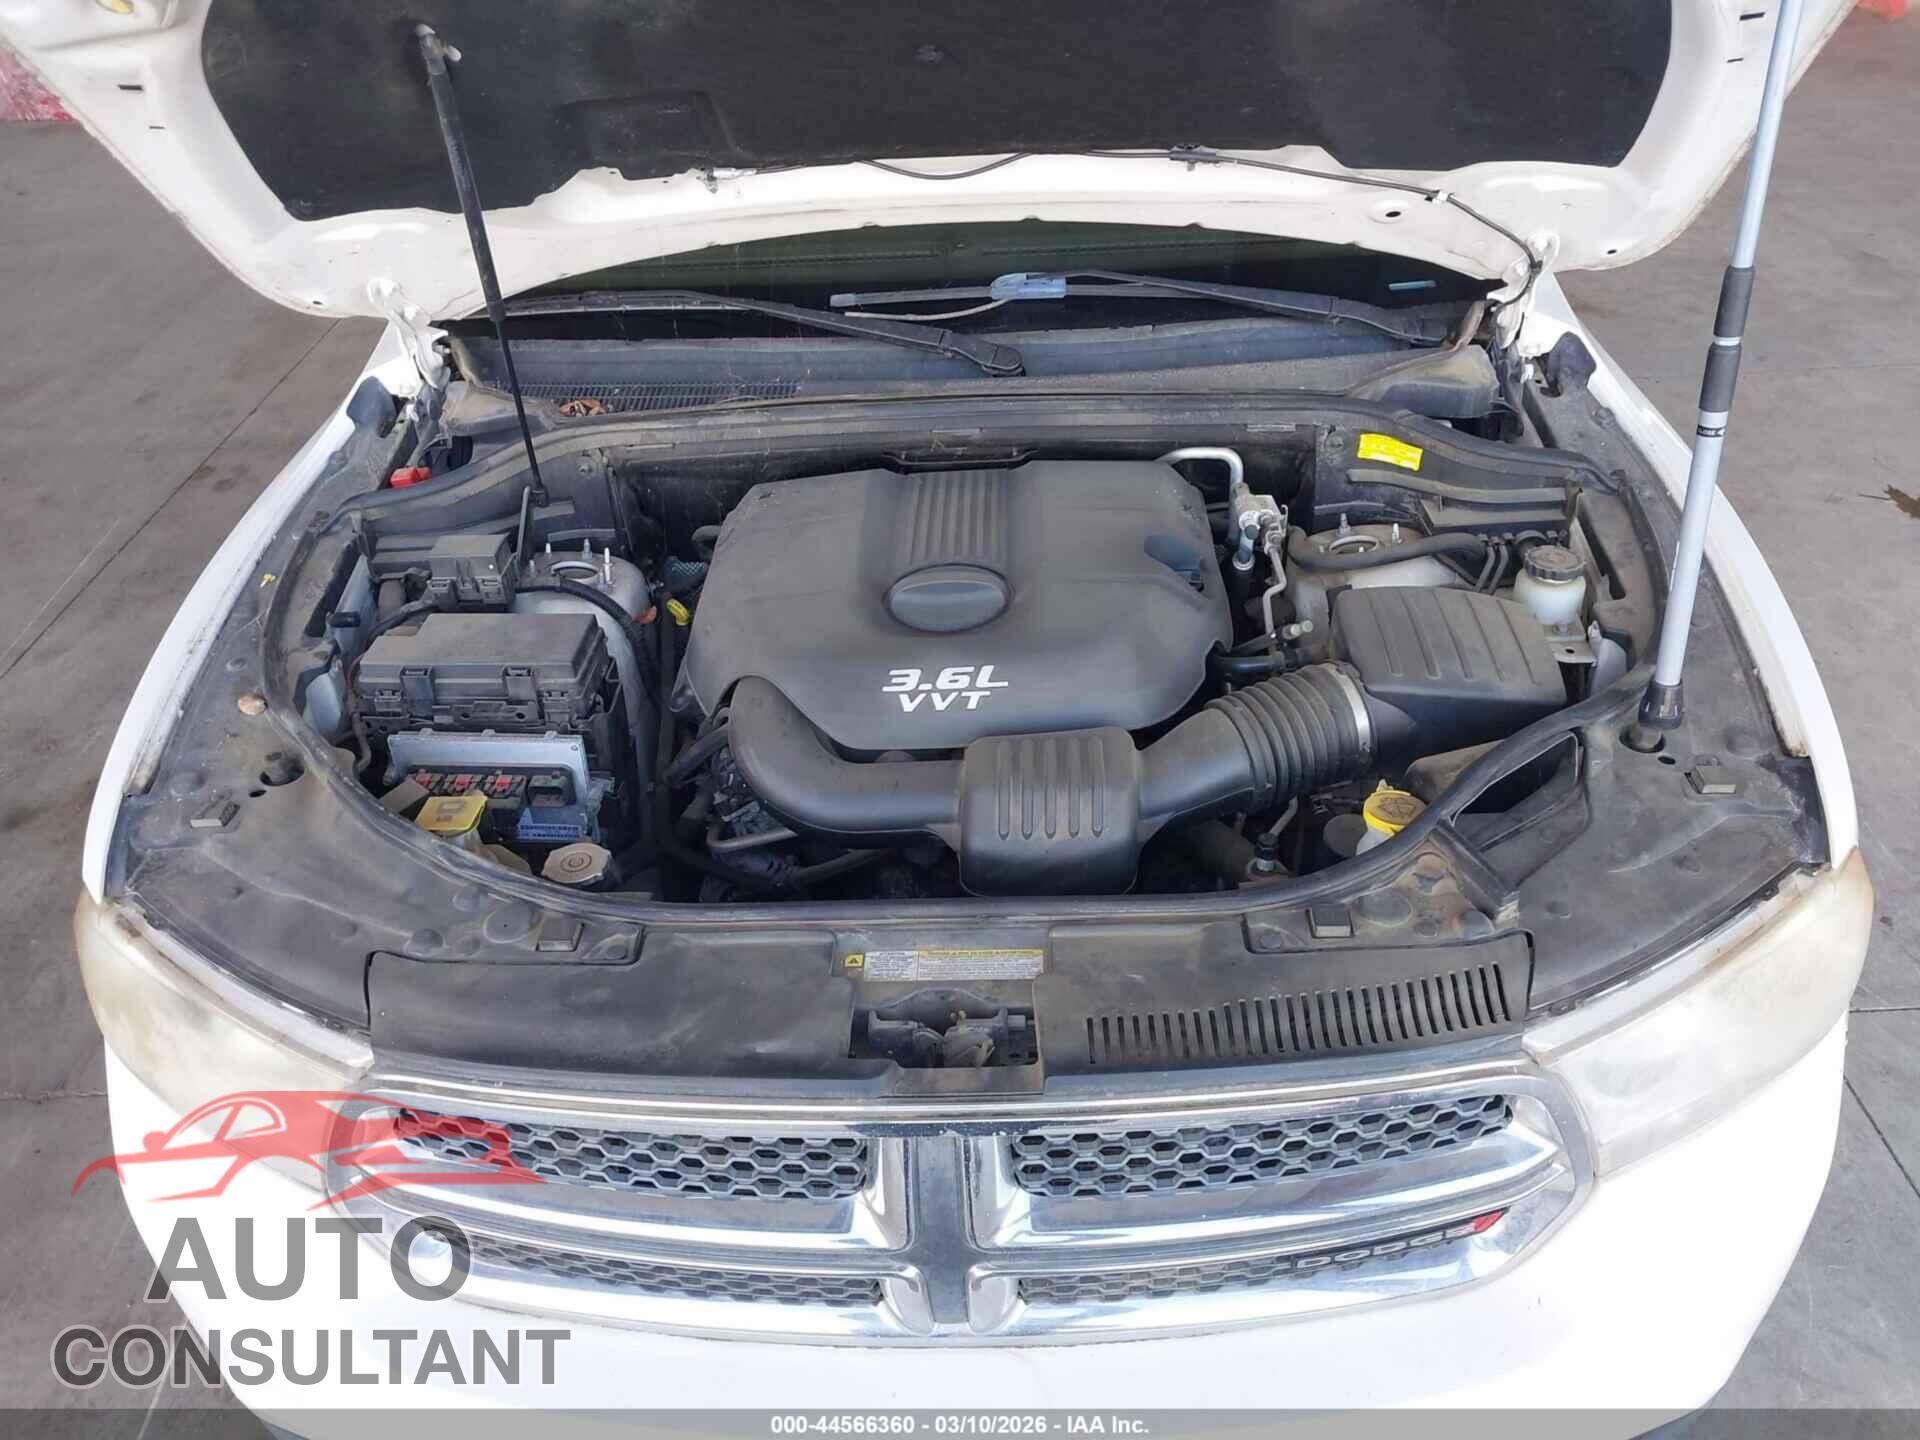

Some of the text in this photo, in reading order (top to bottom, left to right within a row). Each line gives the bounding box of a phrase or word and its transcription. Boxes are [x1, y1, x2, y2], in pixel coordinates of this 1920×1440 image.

[882, 665, 1009, 692] 3.6L
[899, 691, 991, 712] VVT
[1296, 1224, 1475, 1269] DODGE
